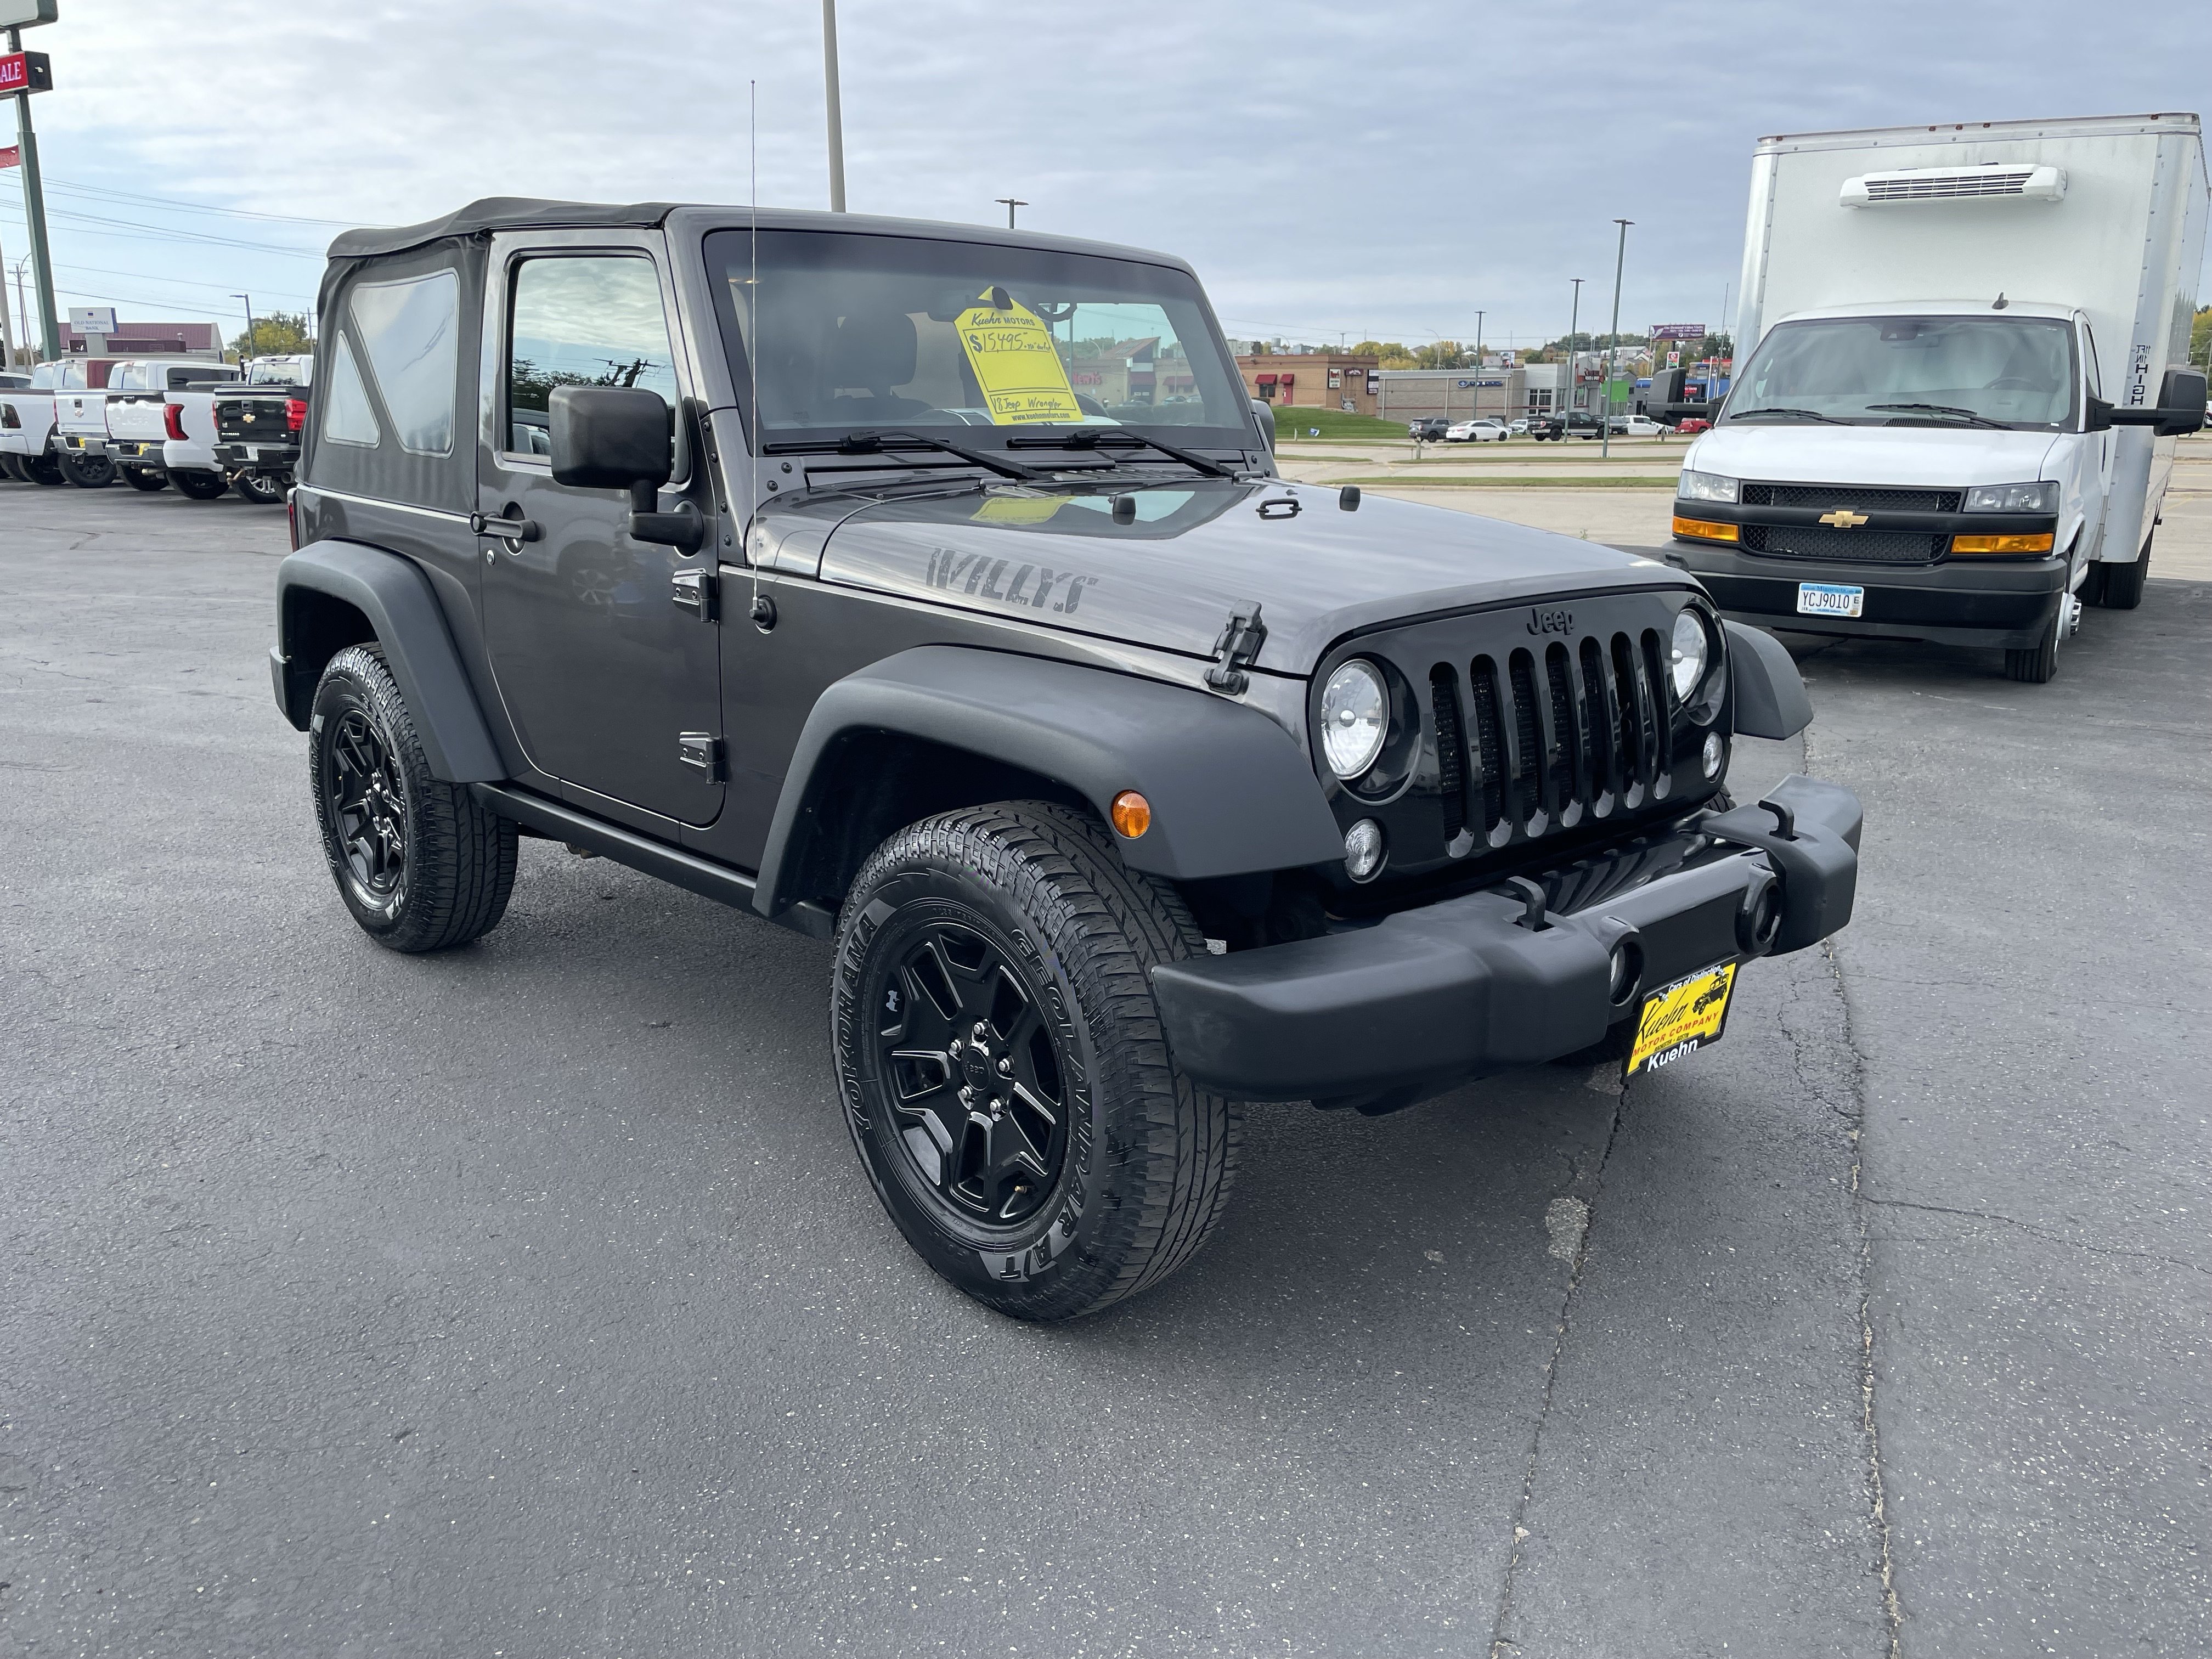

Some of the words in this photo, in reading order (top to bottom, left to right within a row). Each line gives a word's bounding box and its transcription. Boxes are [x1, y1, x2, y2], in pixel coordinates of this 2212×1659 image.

[0, 61, 21, 83] ALE
[972, 312, 1002, 326] Kuehn
[1003, 317, 1035, 326] MOTORS
[1003, 398, 1020, 410] Jeep
[1028, 397, 1062, 413] Wrangler
[1012, 412, 1070, 421] www.kuehnmotors.com
[926, 548, 1099, 613] WILLYS
[1803, 592, 1849, 609] YCJ9010
[1527, 608, 1575, 635] Jeep
[1668, 981, 1681, 992] Cars
[1683, 975, 1690, 986] of
[1691, 965, 1721, 984] Distinction
[839, 911, 878, 1133] YOKOHAMA
[1638, 988, 1689, 1044] Kuehn
[1633, 1034, 1666, 1057] MOTOR
[1669, 1011, 1719, 1037] COMPANY
[1647, 1039, 1698, 1073] Kuehn
[1000, 1233, 1052, 1282] A/T
